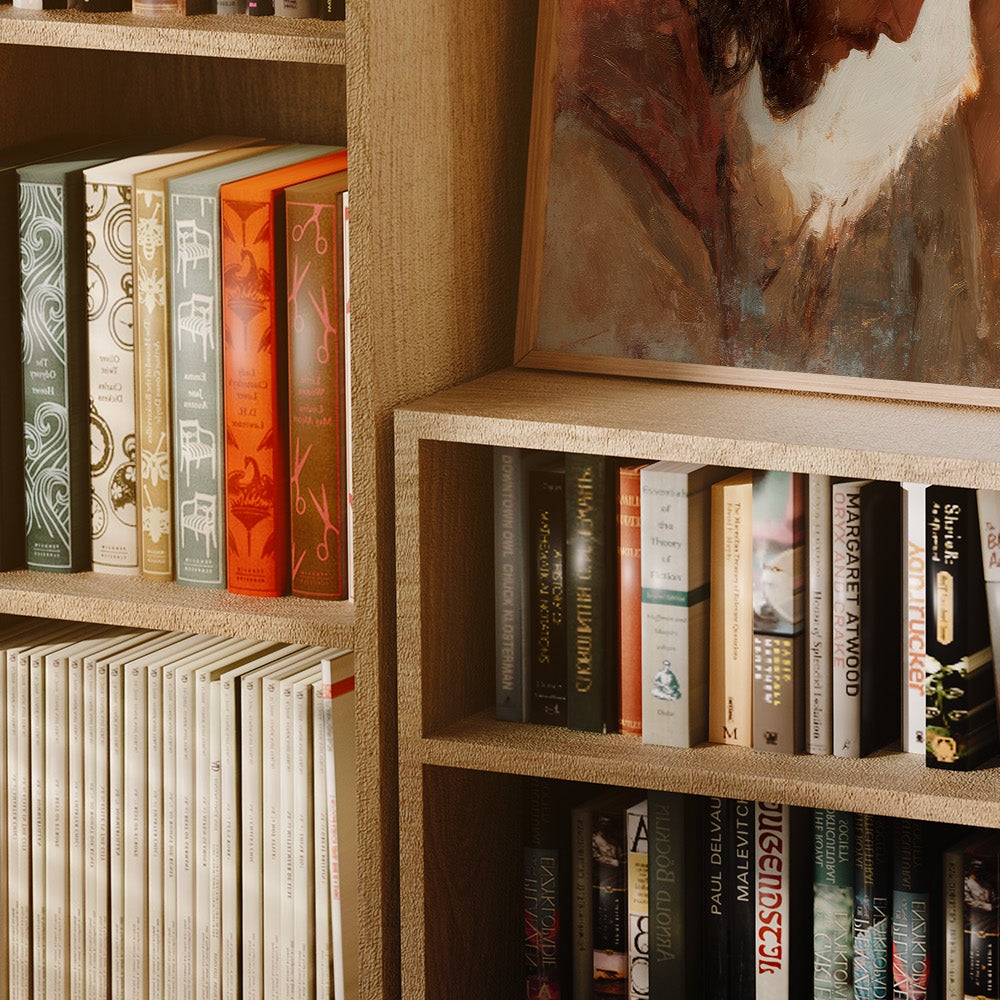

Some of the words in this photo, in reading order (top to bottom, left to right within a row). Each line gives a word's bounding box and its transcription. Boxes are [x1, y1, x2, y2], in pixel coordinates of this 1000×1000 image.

[500, 454, 515, 528] DOWNTOWN
[660, 504, 671, 514] of
[733, 502, 741, 516] The
[658, 521, 674, 531] the
[833, 492, 846, 545] ORYX
[500, 530, 514, 558] OWL
[650, 537, 682, 550] Theory
[661, 554, 672, 565] of
[846, 493, 861, 606] MARGARET
[501, 563, 514, 606] CHUCK
[650, 571, 682, 583] Fiction
[833, 551, 846, 596] AND
[501, 608, 515, 691] KLOSTERMAN
[833, 600, 846, 669] CRAKE
[846, 611, 861, 698] ATWOOD
[722, 727, 738, 740] M
[710, 872, 723, 917] PAUL
